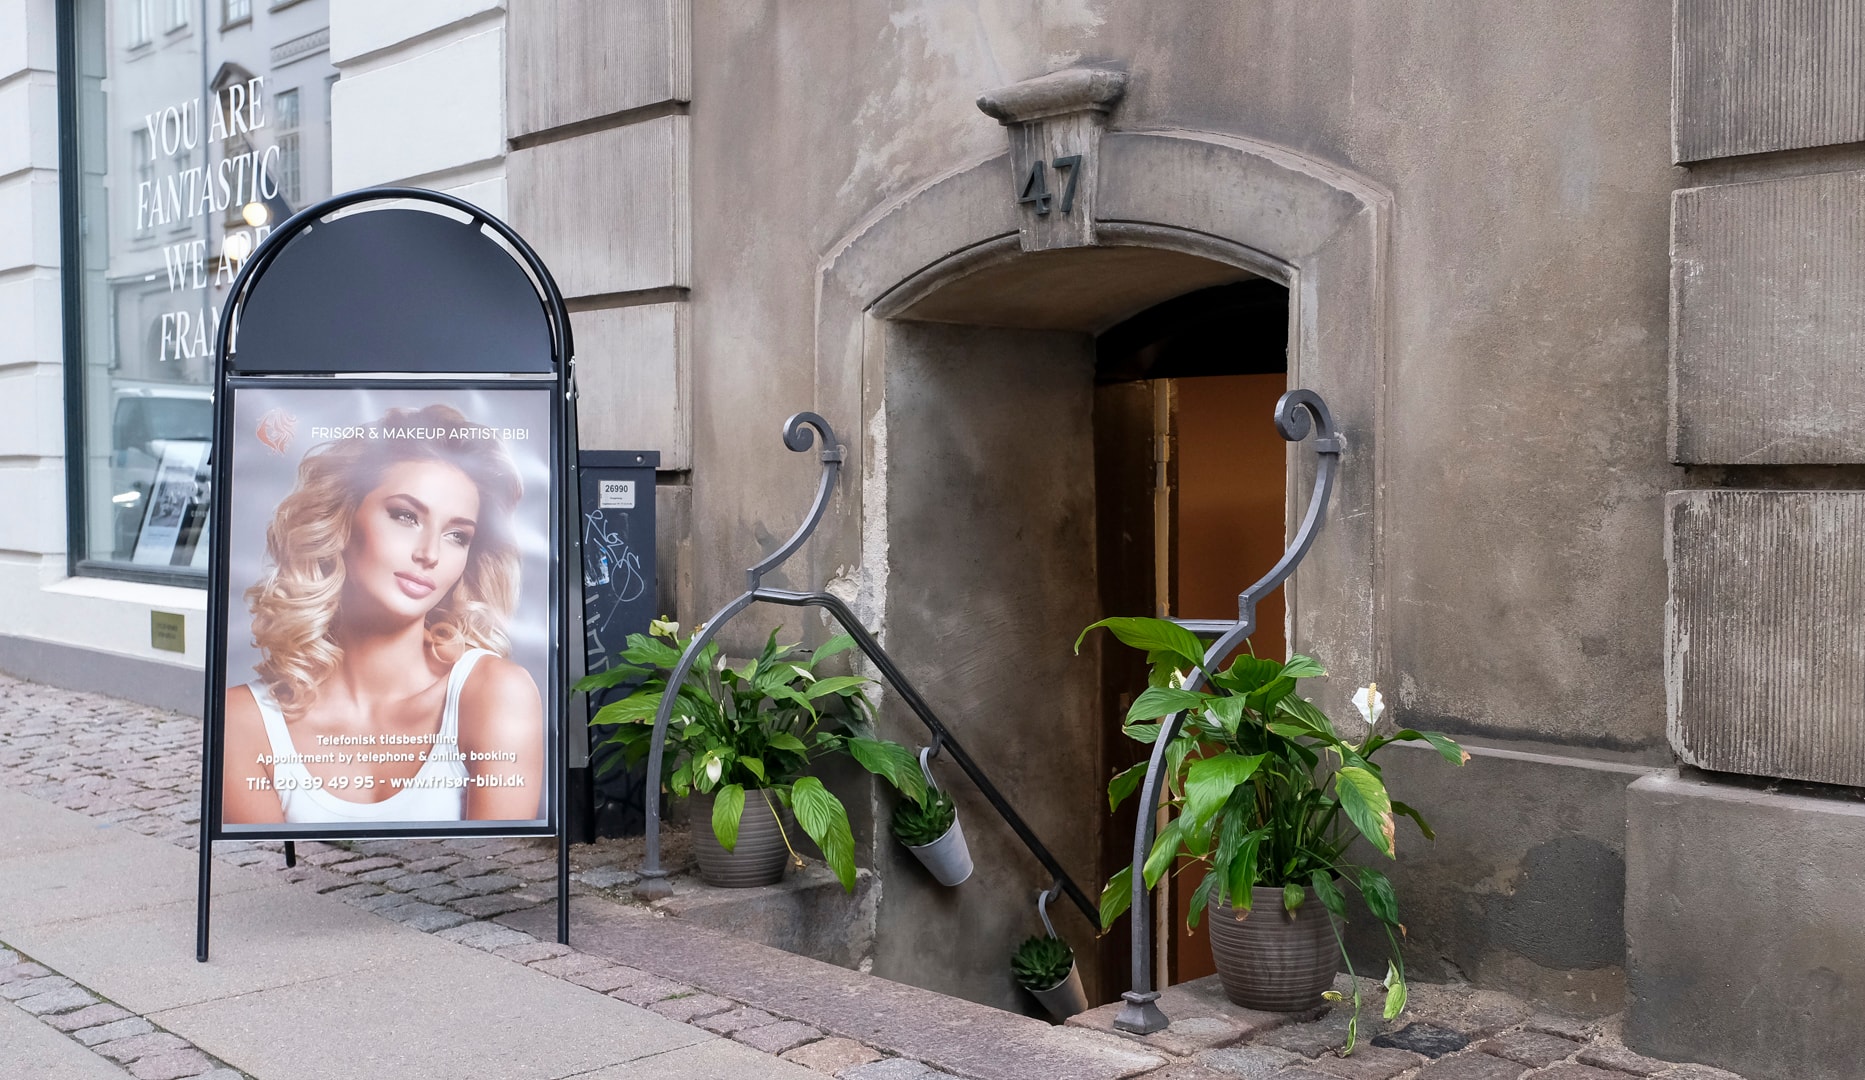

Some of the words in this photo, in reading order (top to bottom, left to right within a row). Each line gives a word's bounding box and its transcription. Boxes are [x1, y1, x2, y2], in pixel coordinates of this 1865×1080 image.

[145, 98, 200, 161] YOU
[208, 76, 266, 144] ARE
[136, 145, 280, 231] FANTASTIC
[1017, 154, 1083, 216] 47
[163, 239, 207, 294] WE
[311, 426, 365, 440] FRISØR
[369, 427, 379, 439] &
[383, 427, 446, 440] MAKEUP
[449, 427, 500, 440] ARTIST
[503, 428, 530, 440] BIBI
[605, 484, 628, 493] 26990
[316, 734, 376, 746] Telefonisk
[380, 733, 458, 746] tidsbestilling
[256, 752, 335, 765] Appointment
[338, 752, 353, 765] by
[357, 751, 415, 763] telephone
[418, 751, 428, 762] &
[431, 751, 467, 761] online
[470, 750, 517, 763] booking
[246, 777, 271, 791] Tlf:
[276, 777, 298, 791] 20
[303, 776, 323, 790] 89
[328, 776, 349, 789] 49
[354, 775, 375, 789] 95
[390, 773, 526, 788] www.frisør-bibi.dk
